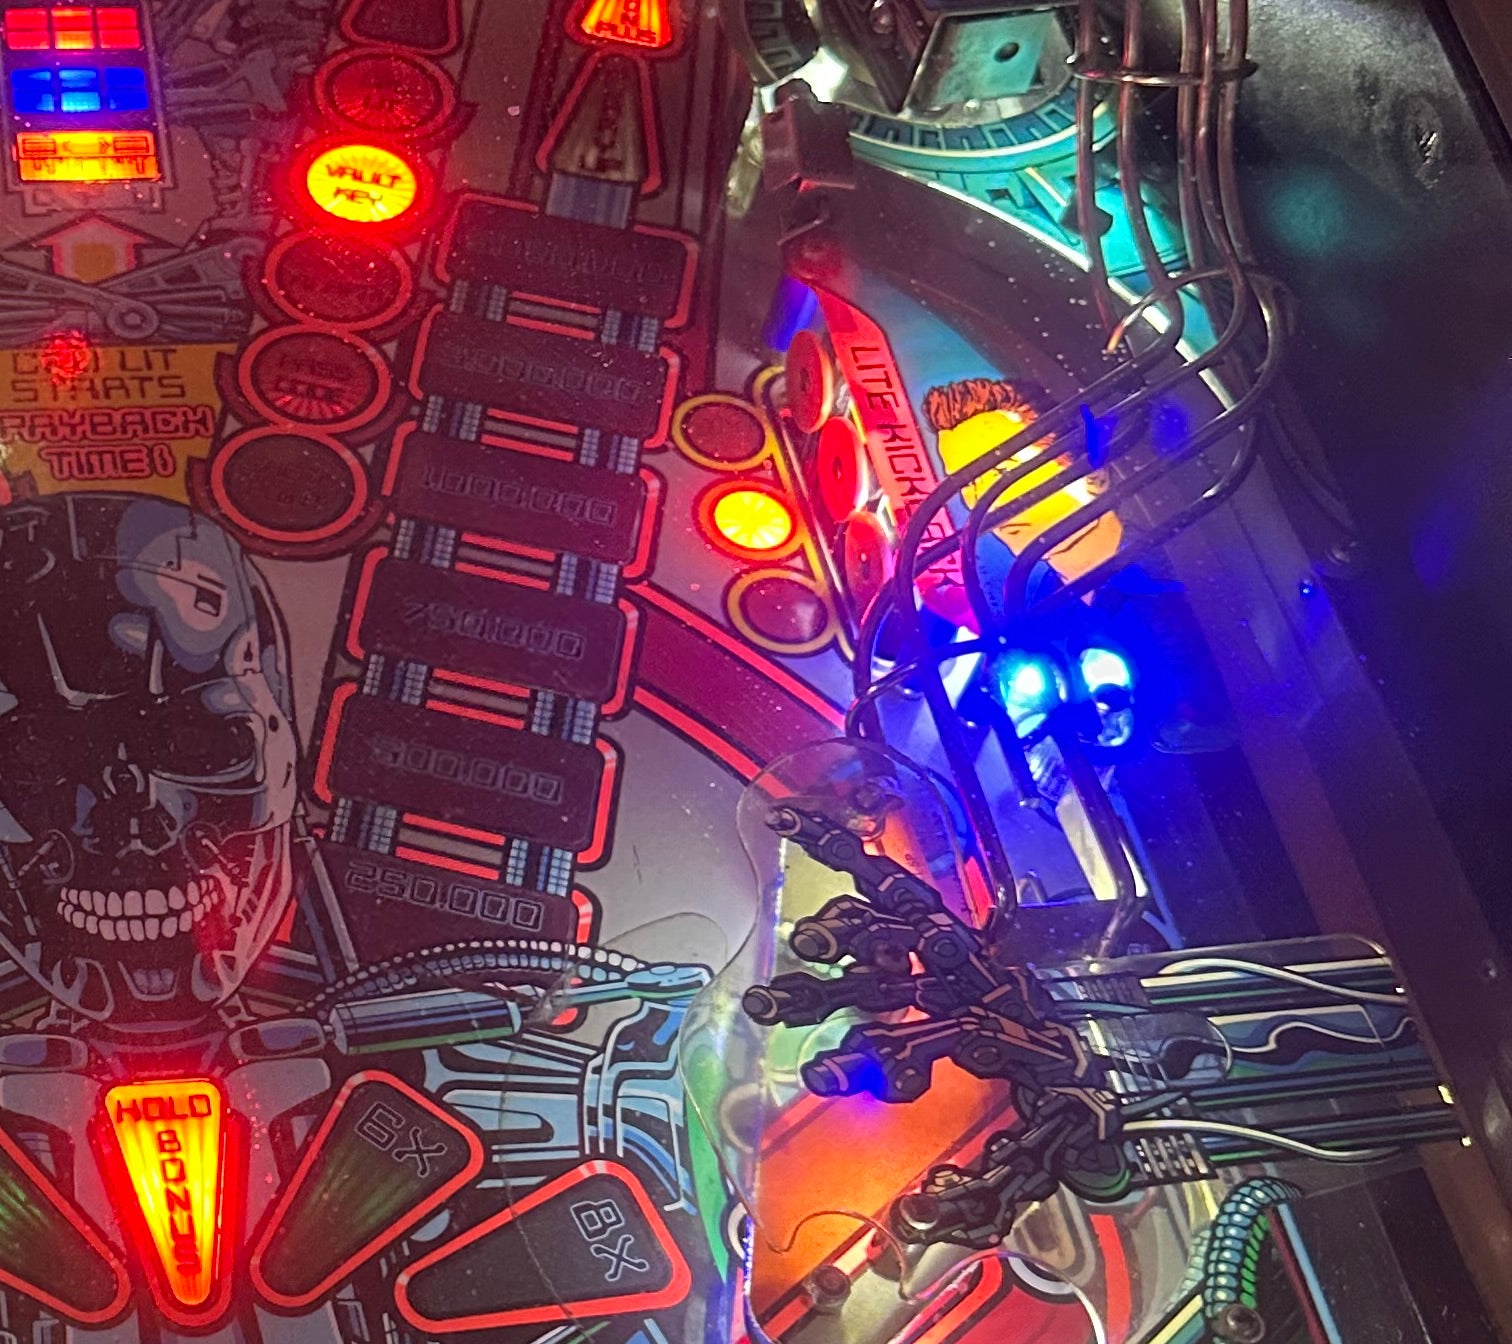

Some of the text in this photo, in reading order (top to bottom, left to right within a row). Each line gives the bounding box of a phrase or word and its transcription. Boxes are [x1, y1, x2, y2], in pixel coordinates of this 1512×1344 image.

[120, 348, 177, 372] LIT
[11, 375, 186, 403] STARTS
[850, 345, 900, 410] LITE
[115, 1093, 213, 1123] HOLD
